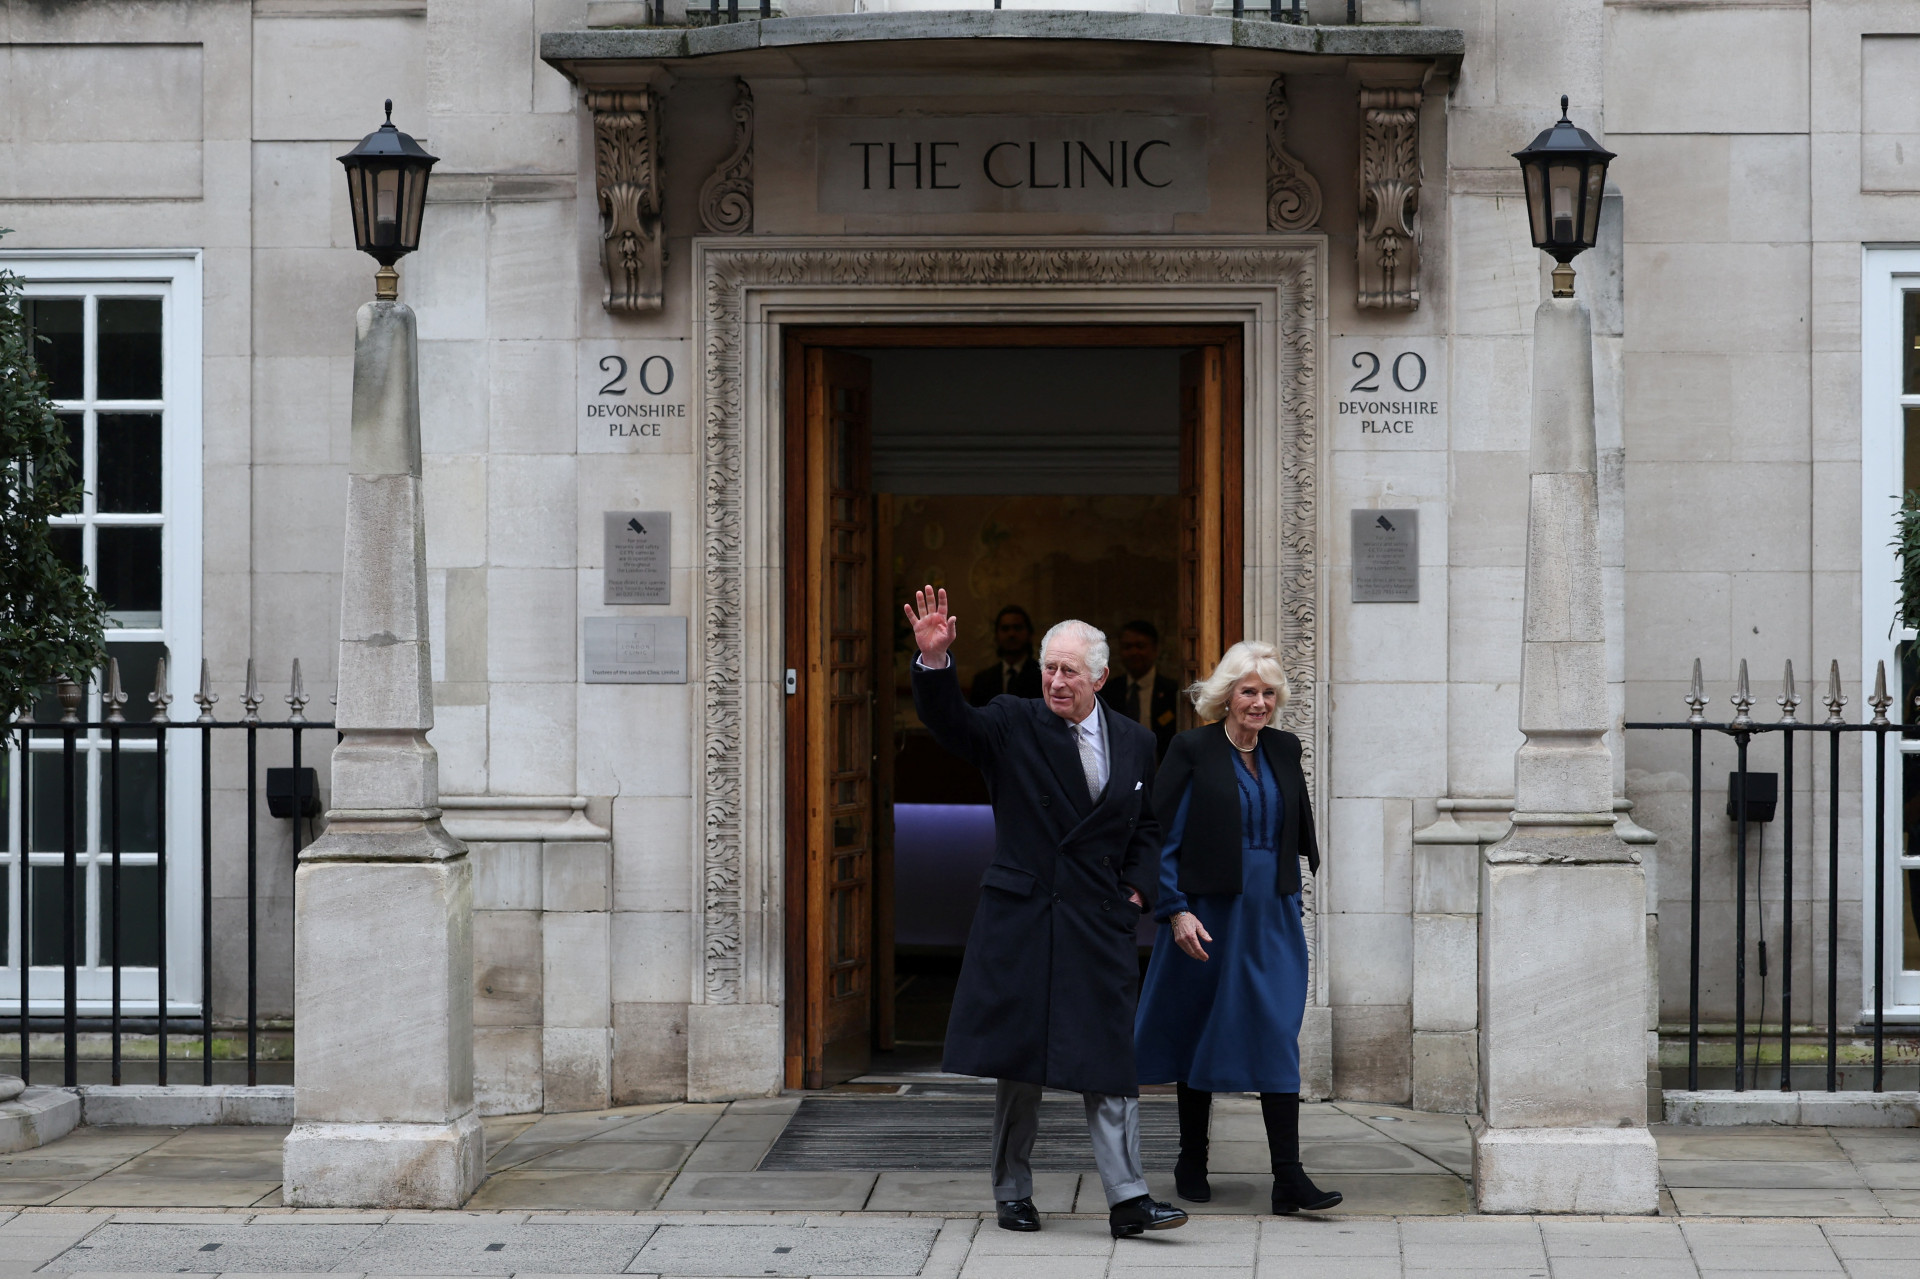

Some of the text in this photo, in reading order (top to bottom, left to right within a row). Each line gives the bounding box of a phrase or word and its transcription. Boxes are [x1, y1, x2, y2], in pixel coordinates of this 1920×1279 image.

[850, 139, 1173, 190] THE CLINIC
[599, 355, 674, 396] 20
[1350, 351, 1427, 393] 20
[587, 404, 686, 418] DEVONSHIRE
[1338, 401, 1439, 415] DEVONSHIRE
[609, 423, 661, 437] PLACE
[1361, 420, 1414, 434] PLACE
